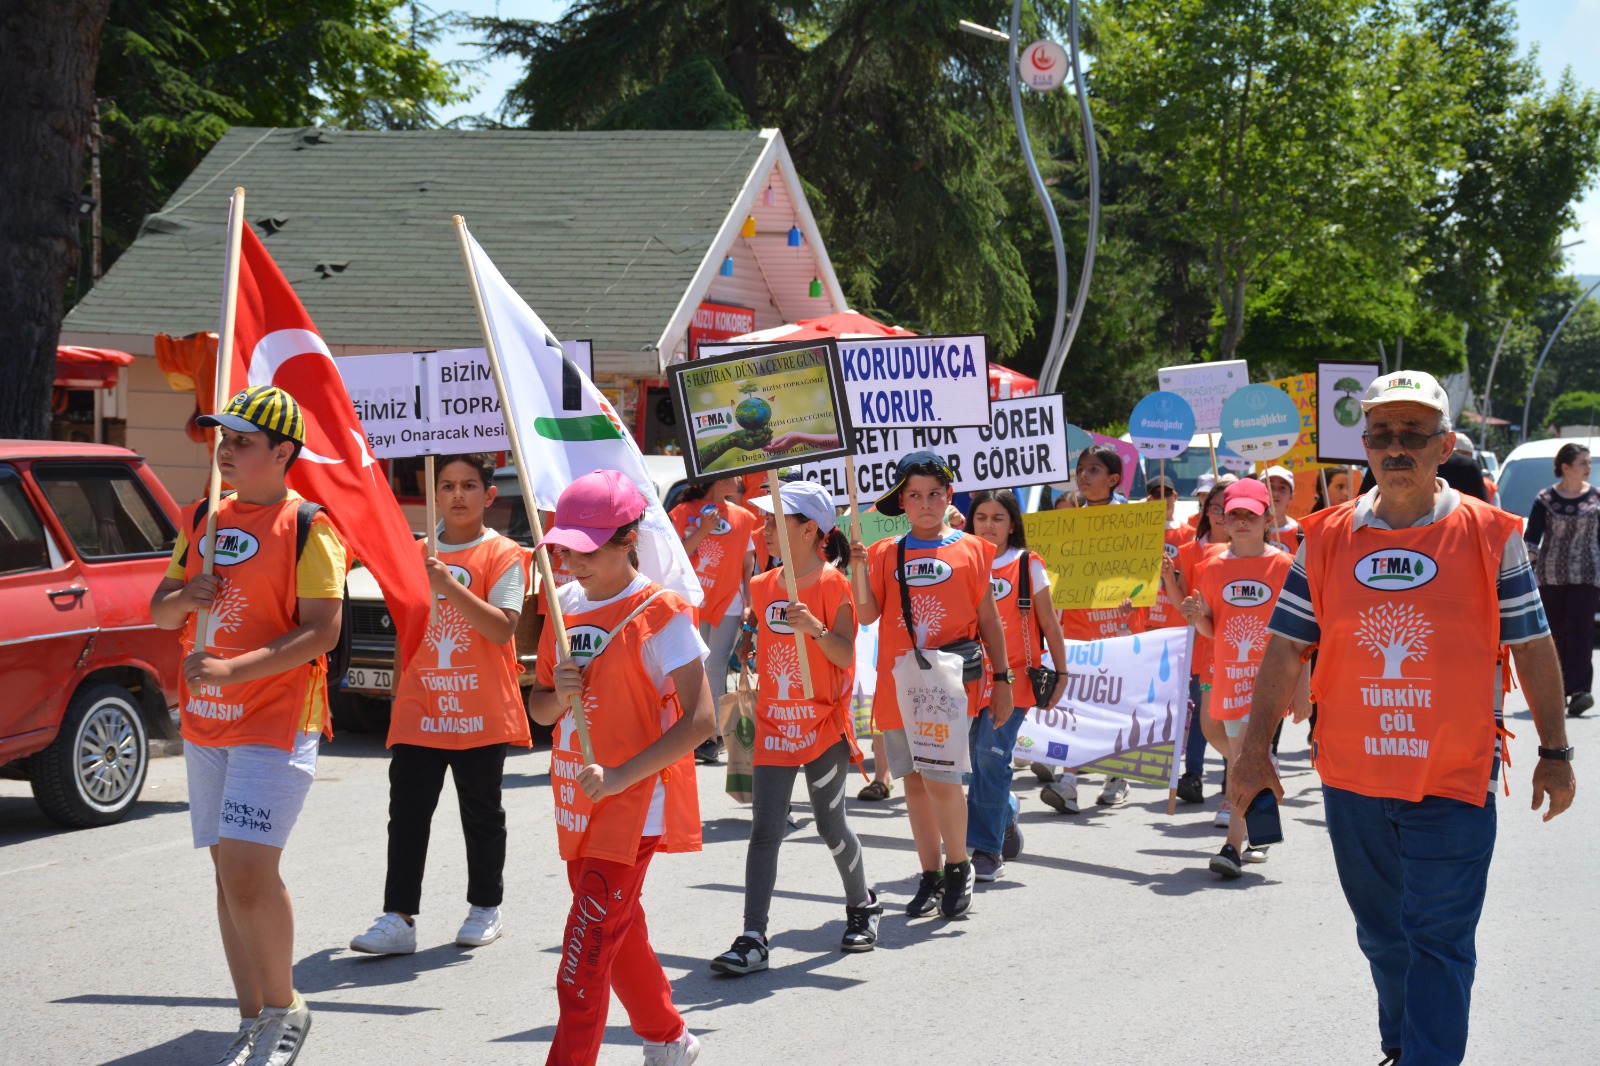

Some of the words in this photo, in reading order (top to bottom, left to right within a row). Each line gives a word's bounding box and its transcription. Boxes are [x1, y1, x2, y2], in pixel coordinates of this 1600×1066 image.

[441, 361, 493, 383] BİZİM
[686, 375, 692, 388] 5
[693, 367, 732, 387] HAZİRAN
[735, 361, 766, 379] DÜNYA
[765, 356, 796, 374] ÇEVRE
[842, 344, 977, 381] KORUDUKÇA
[1388, 377, 1413, 388] TEMA
[859, 389, 942, 424] KORUR.
[695, 412, 725, 428] TEMA
[977, 406, 1055, 443] GÖREN
[401, 425, 469, 442] Onaracak
[973, 444, 1057, 482] GÖRÜR.
[1026, 516, 1076, 538] BİZİM
[1084, 510, 1164, 533] TOPRAĞIMIZ
[906, 563, 935, 576] TEMA
[1083, 556, 1161, 578] ONARACAK
[1371, 557, 1411, 575] TEMA
[1231, 585, 1256, 597] TEMA
[771, 606, 788, 620] TEM
[348, 670, 365, 686] 60
[373, 671, 391, 688] ZD
[420, 672, 479, 692] TÜRKİYE
[437, 691, 464, 716] ÇÖL
[1360, 684, 1432, 708] TÜRKİYE
[767, 703, 817, 721] TÜRKİYE
[1380, 709, 1416, 735] ÇÖL
[420, 715, 484, 734] OLMASIN
[1364, 736, 1429, 759] OLMASIN
[562, 871, 608, 986] Dreams
